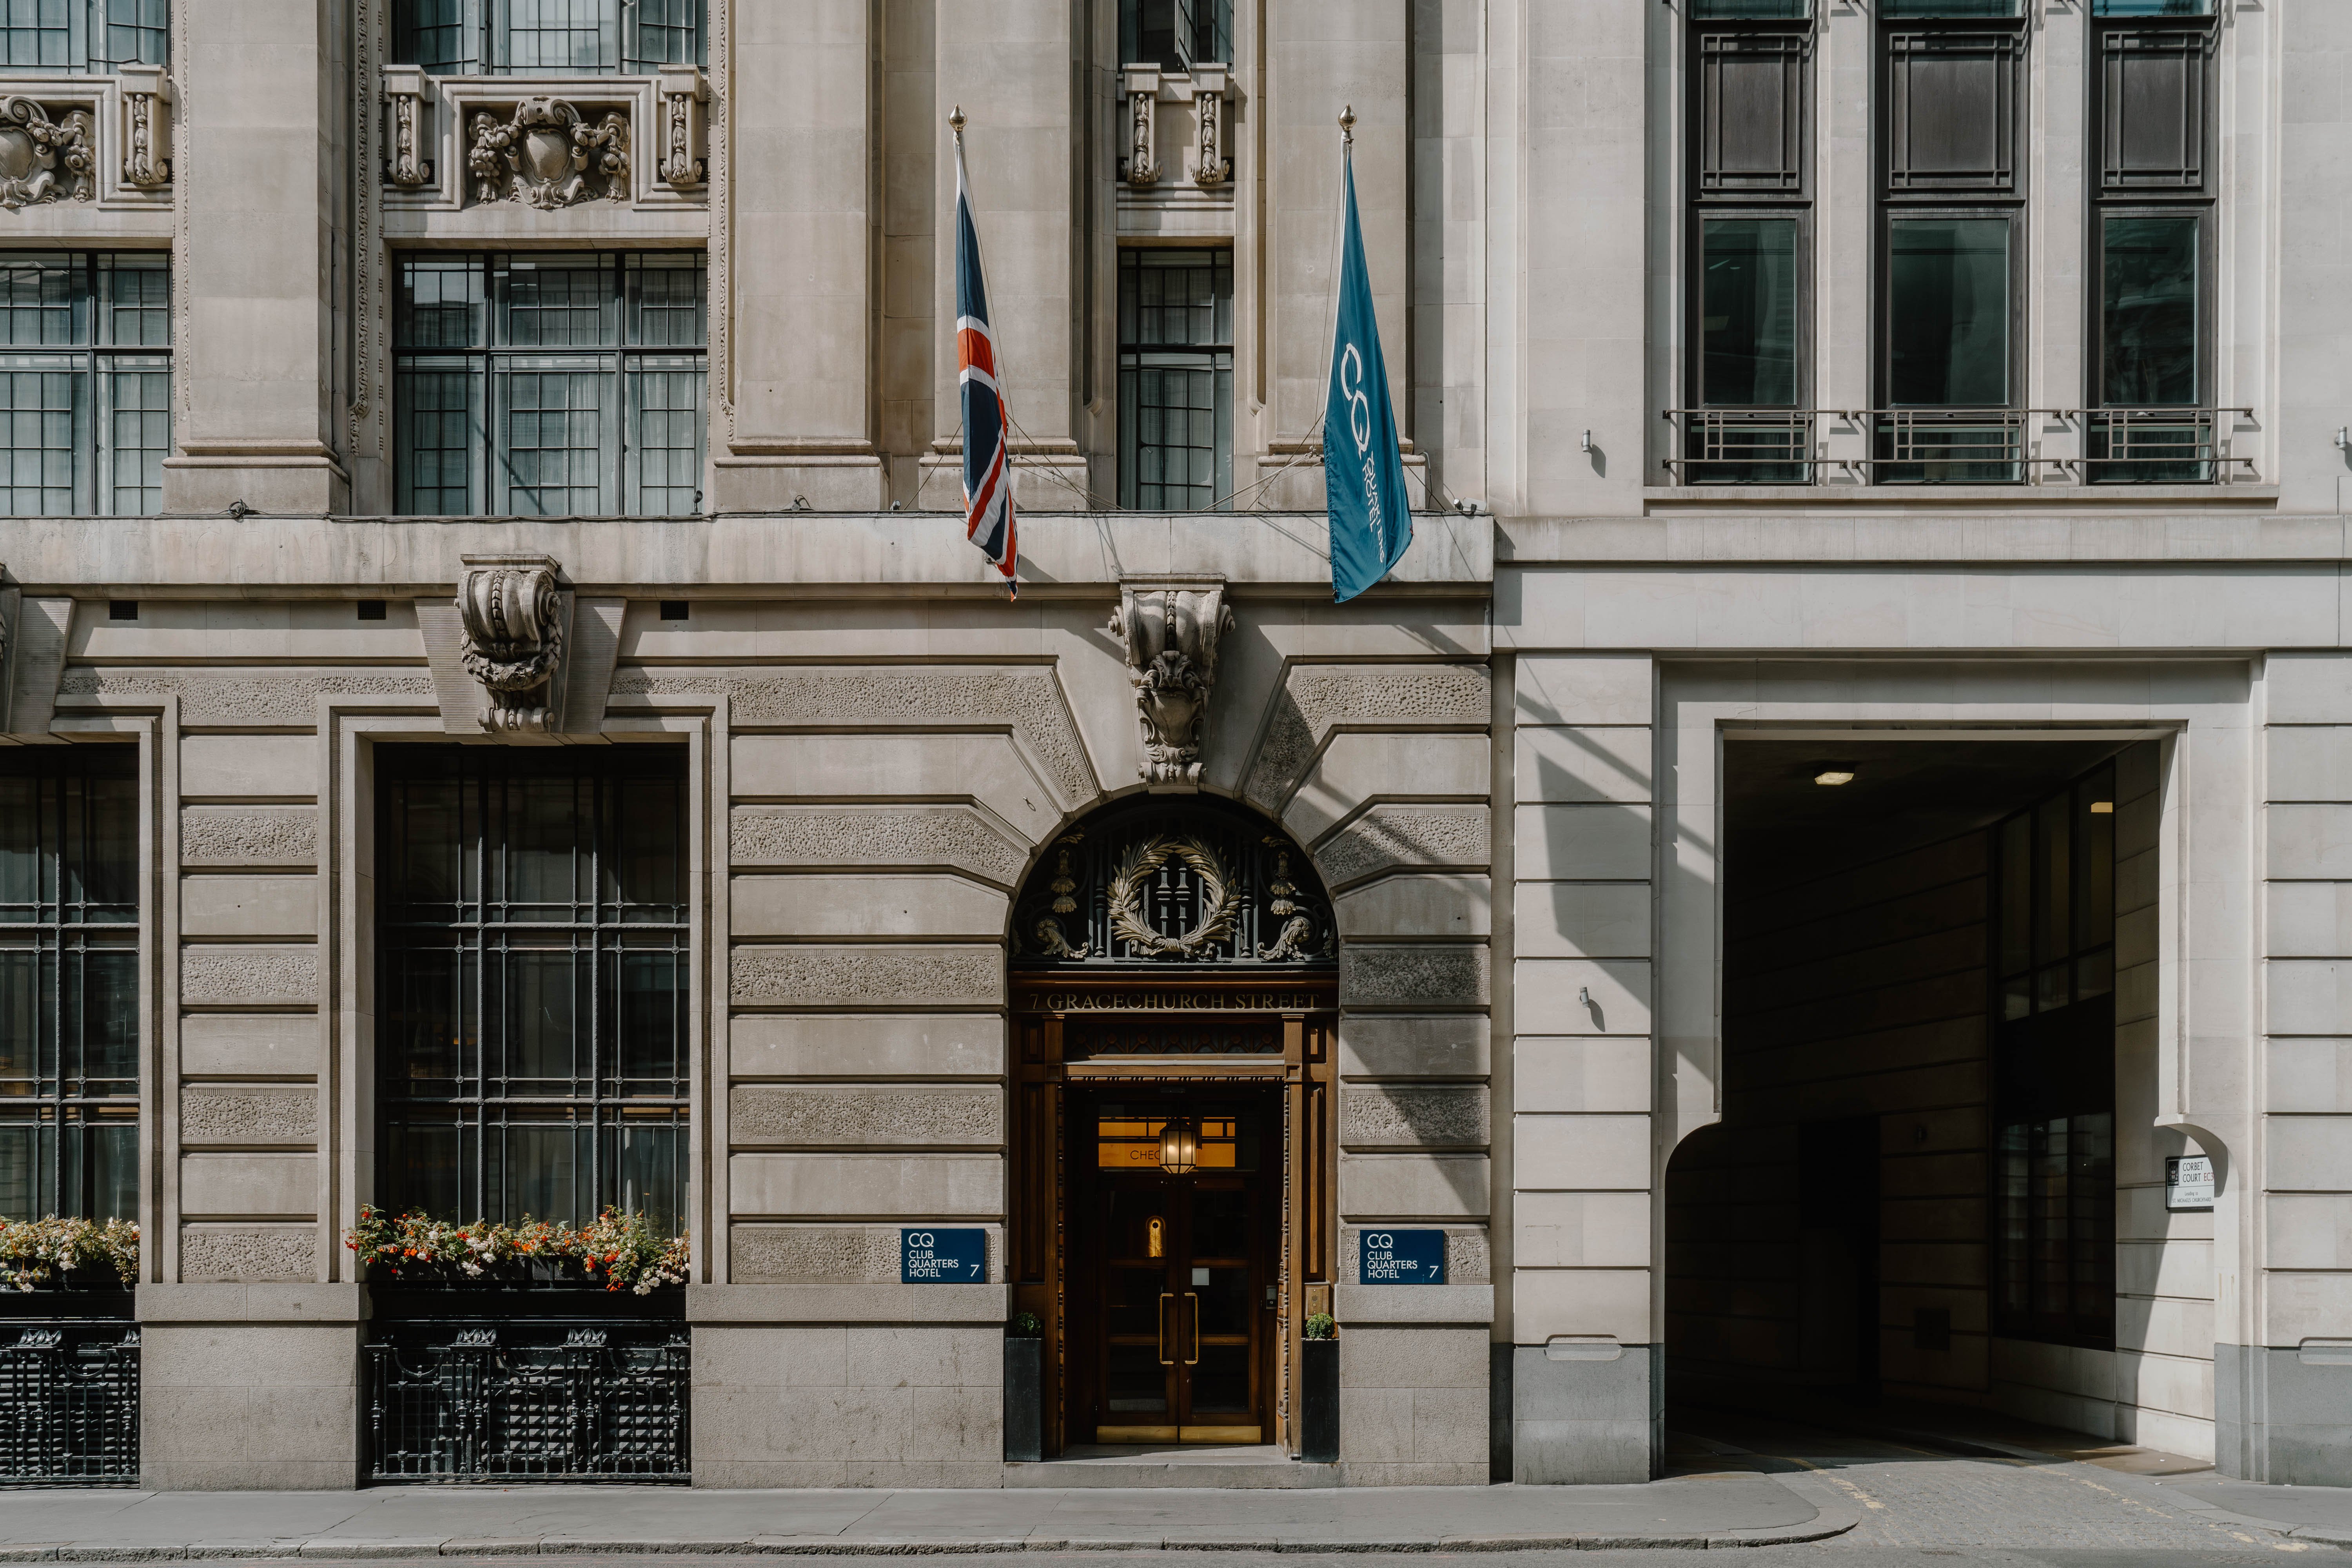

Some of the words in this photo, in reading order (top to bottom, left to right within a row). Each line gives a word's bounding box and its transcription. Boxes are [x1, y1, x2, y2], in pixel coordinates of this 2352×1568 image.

[1341, 343, 1370, 461] CQ
[1363, 463, 1376, 533] HOTEL
[1029, 994, 1038, 1009] 7
[1047, 994, 1226, 1009] GRACECHURCH
[1236, 994, 1319, 1009] STREET
[1130, 1150, 1160, 1160] CHEC
[2183, 1161, 2203, 1171] CORBET
[2183, 1173, 2201, 1182] COURT
[2204, 1172, 2214, 1181] EC3
[908, 1233, 934, 1247] CQ
[1367, 1234, 1393, 1249] CQ
[909, 1250, 933, 1259] CLUB
[1368, 1252, 1392, 1260] CLUB
[909, 1259, 958, 1268] QUARTERS
[1367, 1260, 1417, 1269] QUARTERS
[909, 1269, 941, 1277] HOTEL
[970, 1265, 980, 1277] 7
[1368, 1270, 1399, 1278] HOTEL
[1429, 1266, 1439, 1278] 7
